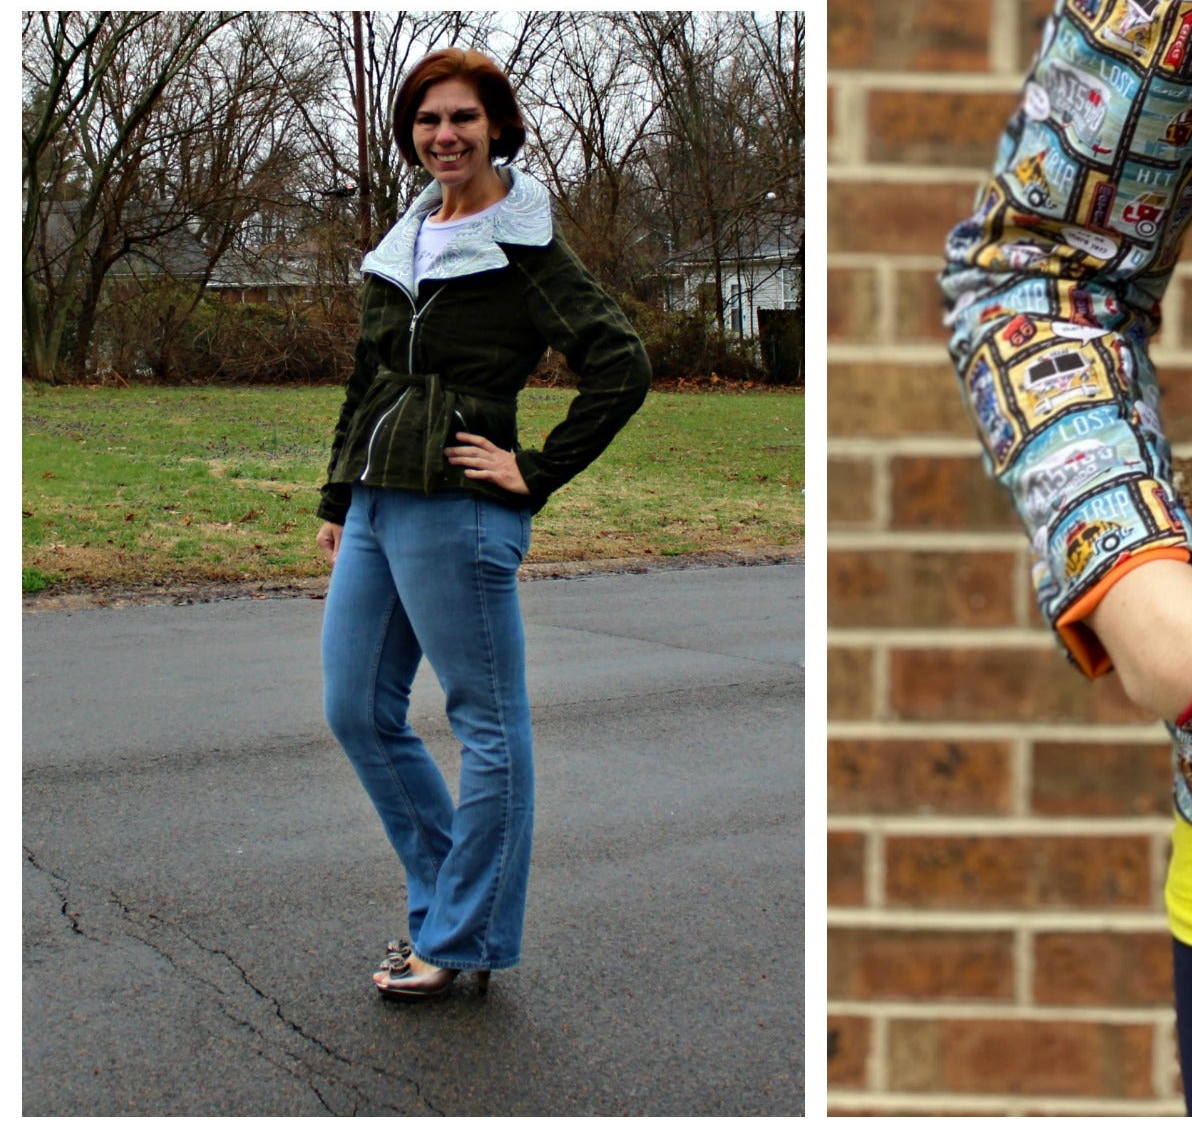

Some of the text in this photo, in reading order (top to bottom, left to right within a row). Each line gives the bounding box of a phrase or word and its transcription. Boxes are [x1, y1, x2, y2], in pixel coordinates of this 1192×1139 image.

[1137, 169, 1173, 187] HIT
[1011, 323, 1034, 345] 66
[1081, 490, 1130, 522] TRIP
